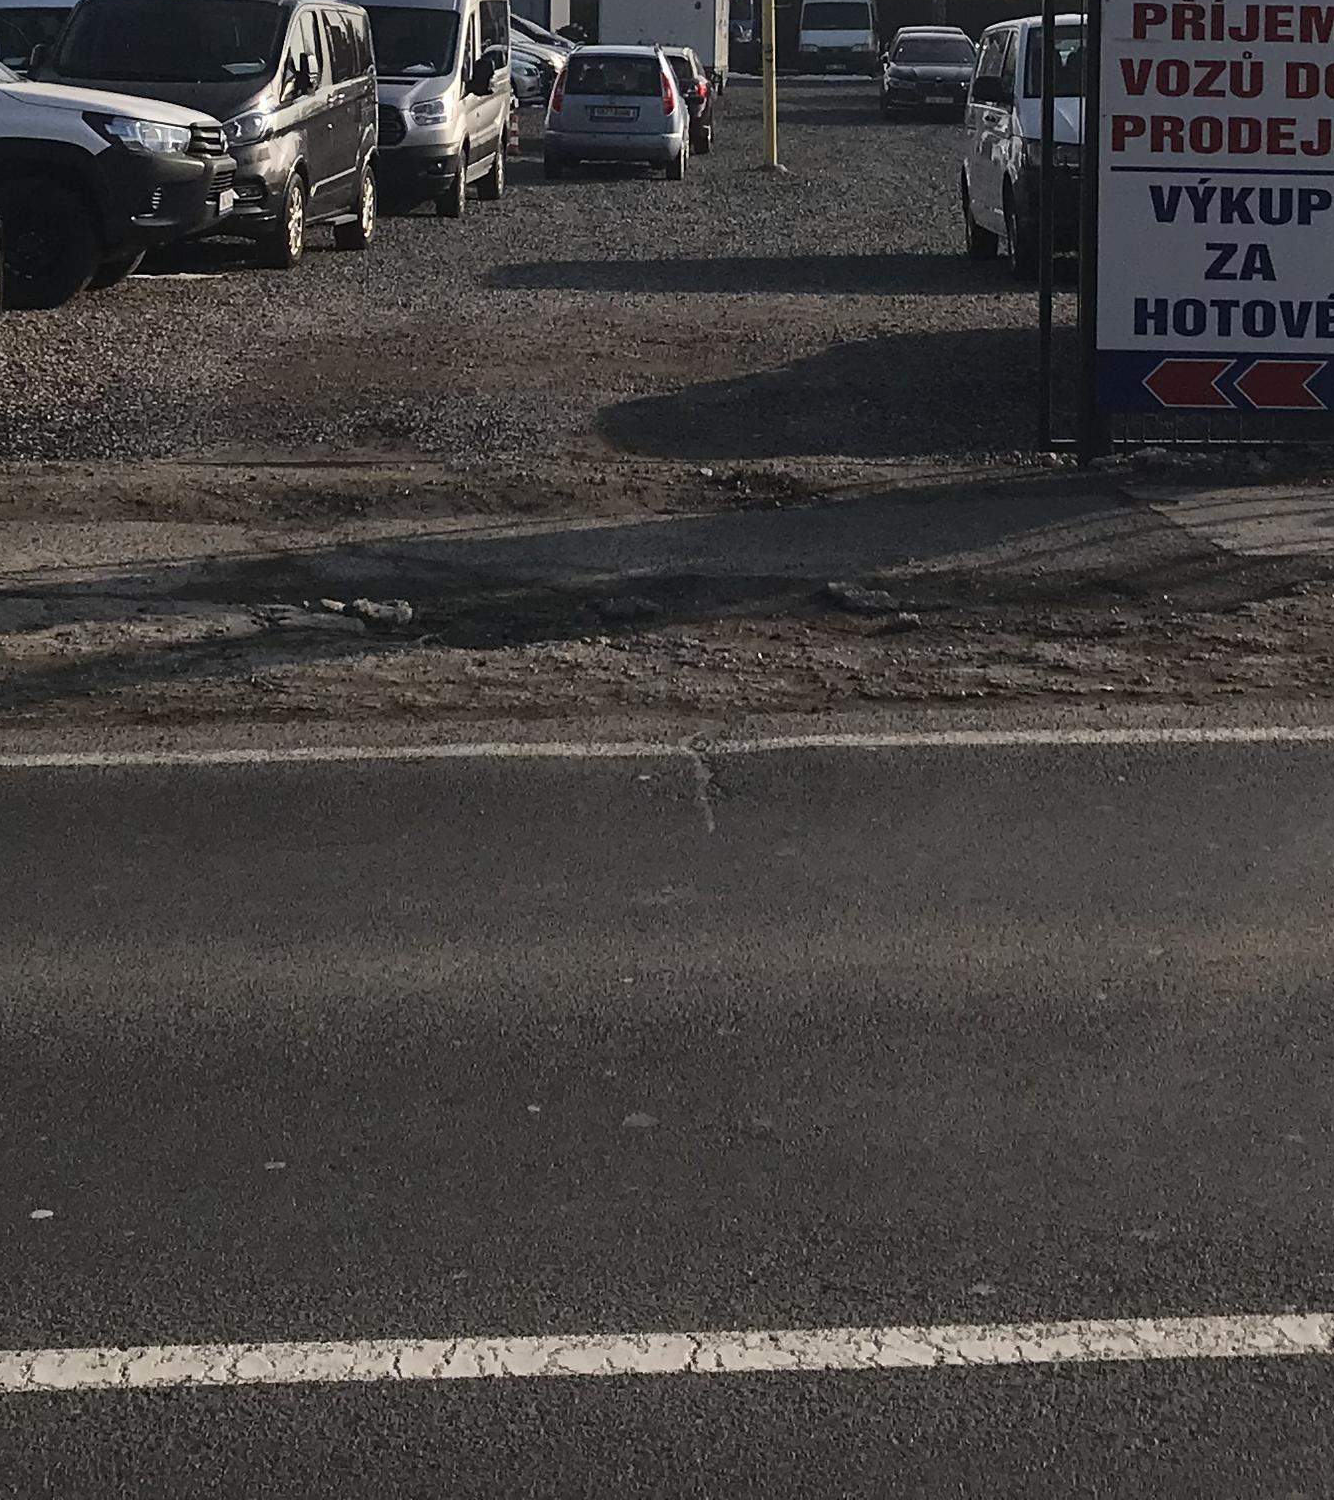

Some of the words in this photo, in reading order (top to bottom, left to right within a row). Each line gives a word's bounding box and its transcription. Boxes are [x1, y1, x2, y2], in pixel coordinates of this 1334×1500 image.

[1119, 51, 1264, 99] VOZŮ
[1148, 178, 1333, 226] VÝKUP
[1204, 242, 1277, 282] ZA
